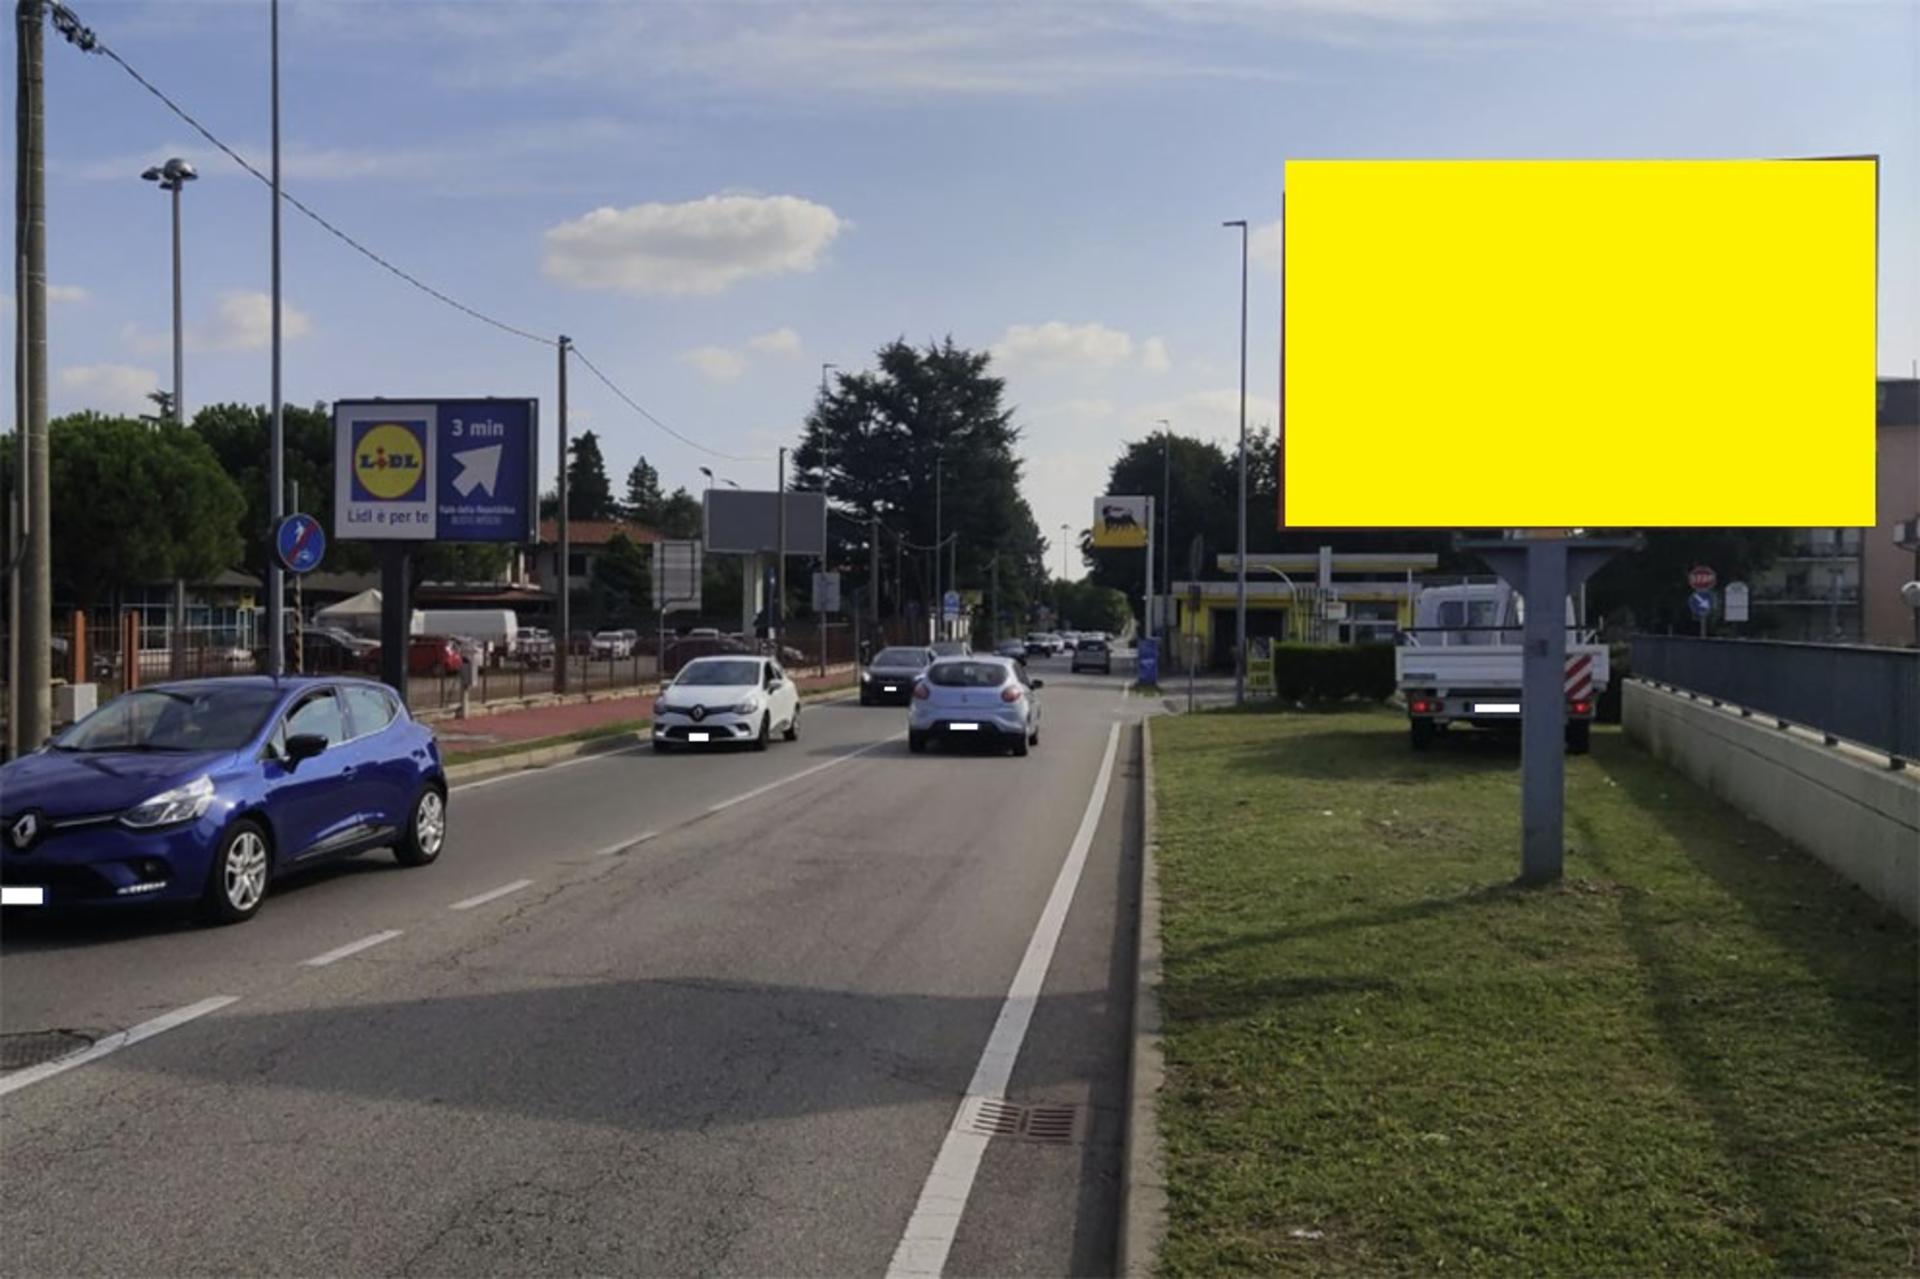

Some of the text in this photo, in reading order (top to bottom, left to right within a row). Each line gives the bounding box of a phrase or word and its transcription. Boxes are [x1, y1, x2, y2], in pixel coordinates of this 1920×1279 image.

[452, 418, 503, 437] 3 min
[347, 508, 372, 524] Lidl
[389, 511, 412, 525] per
[415, 509, 430, 524] te
